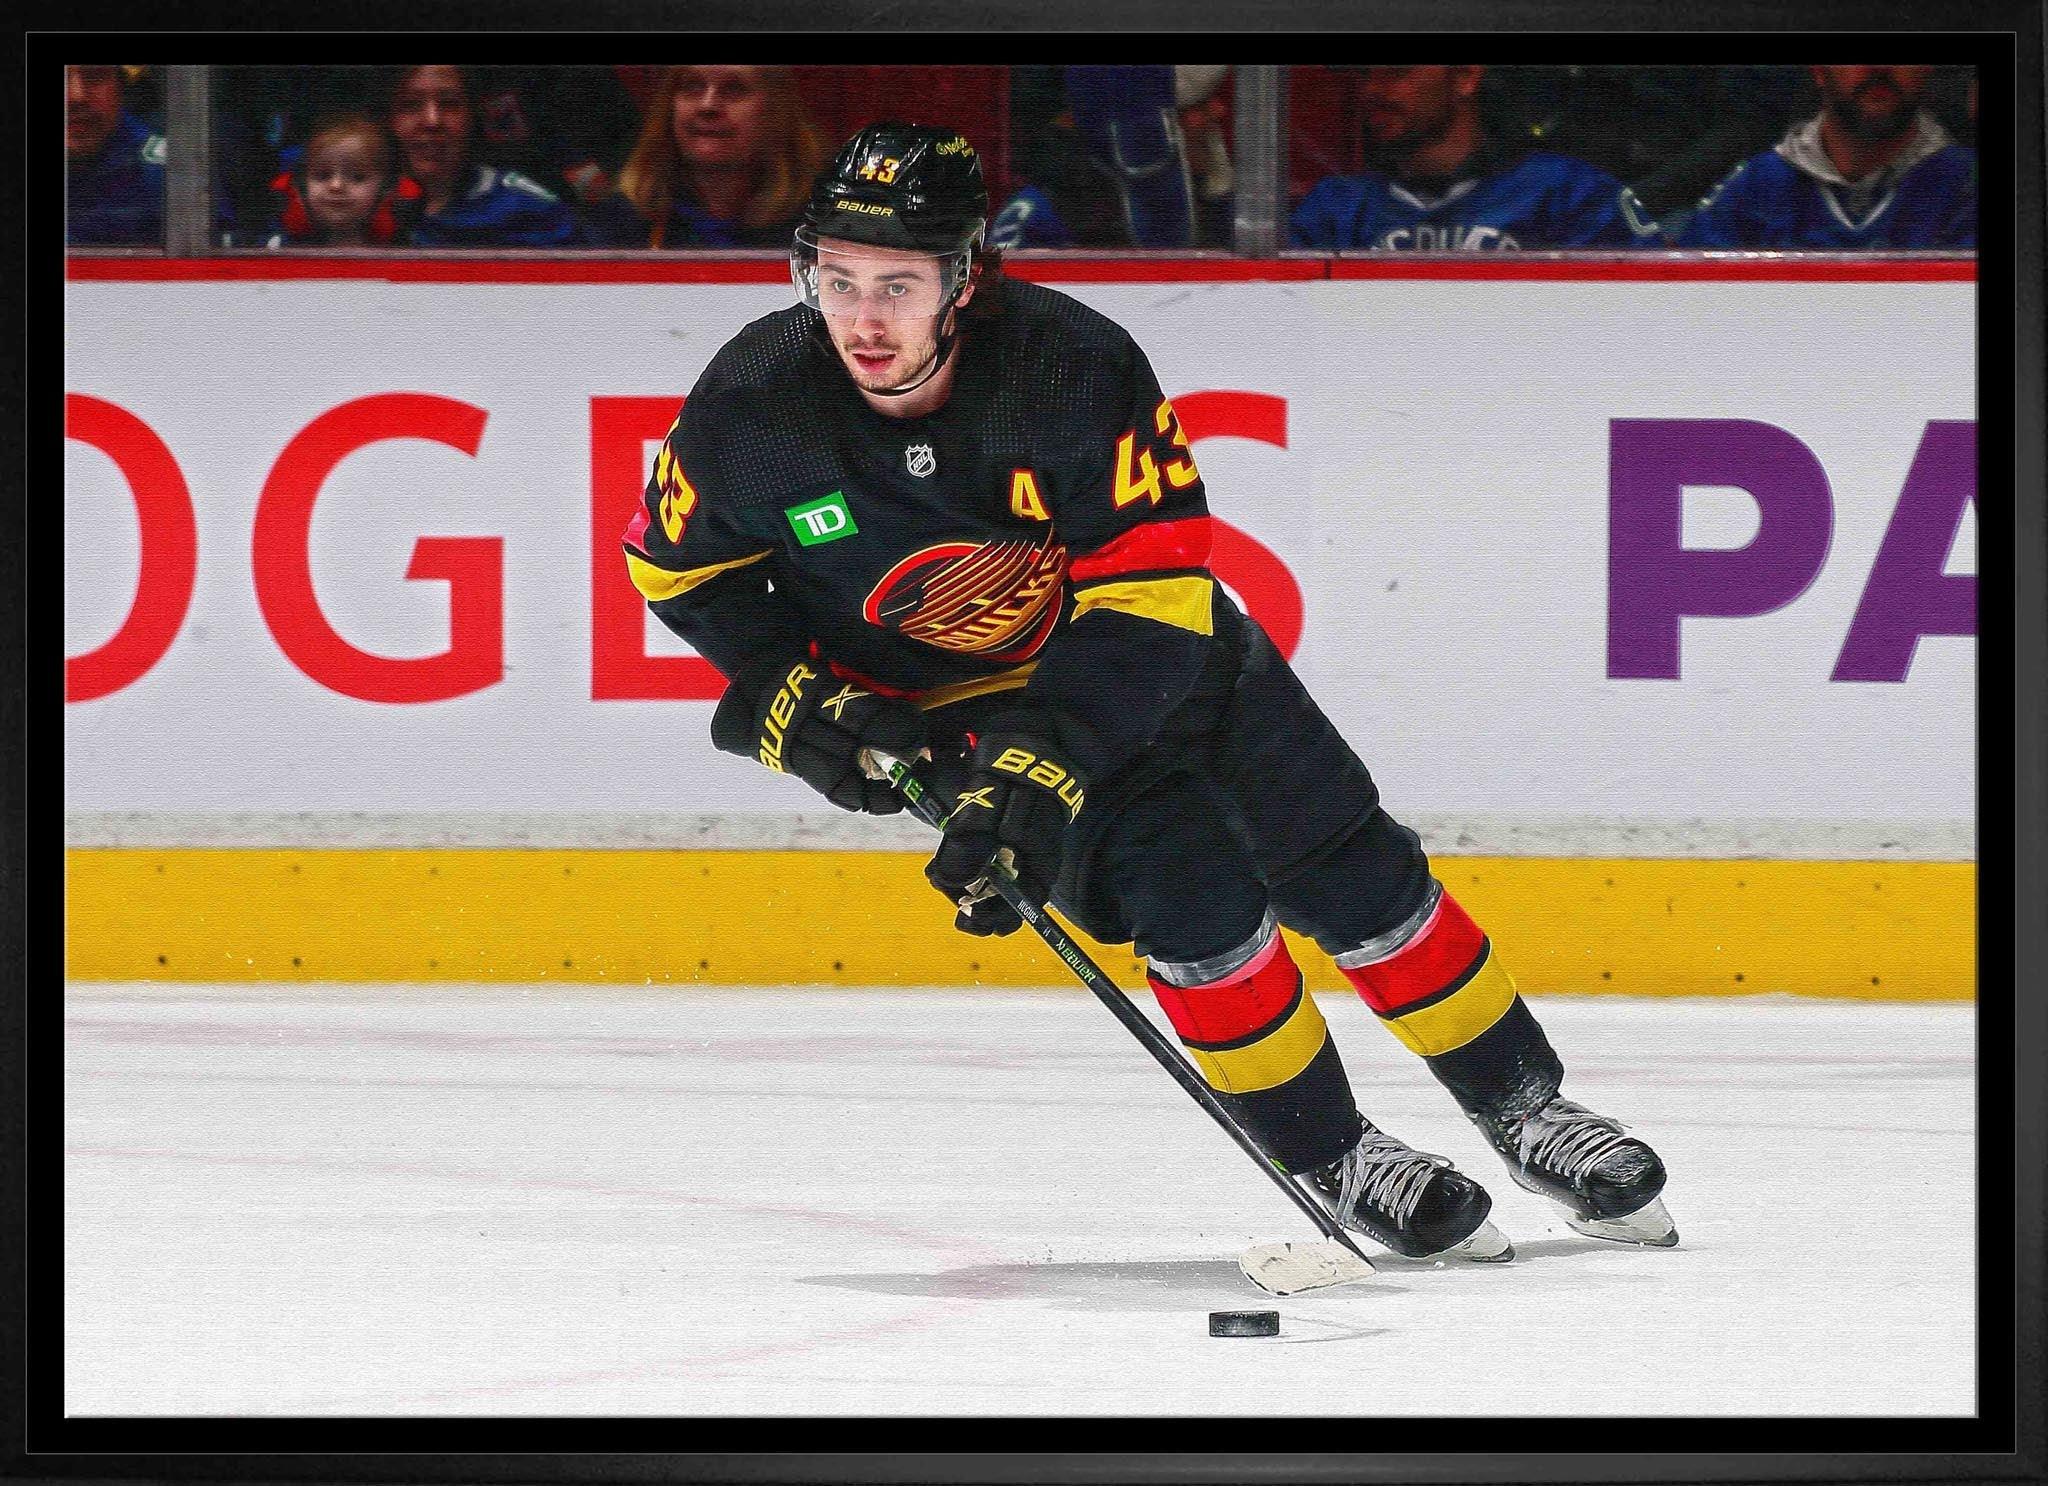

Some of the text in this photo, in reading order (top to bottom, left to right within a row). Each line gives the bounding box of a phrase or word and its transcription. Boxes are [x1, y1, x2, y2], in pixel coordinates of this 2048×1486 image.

[859, 157, 900, 184] 43
[836, 200, 894, 217] BAUER
[1112, 397, 1200, 509] 43
[1011, 471, 1050, 521] A
[793, 504, 847, 537] TD
[1606, 418, 1979, 683] PA
[1061, 947, 1098, 984] BAUER
